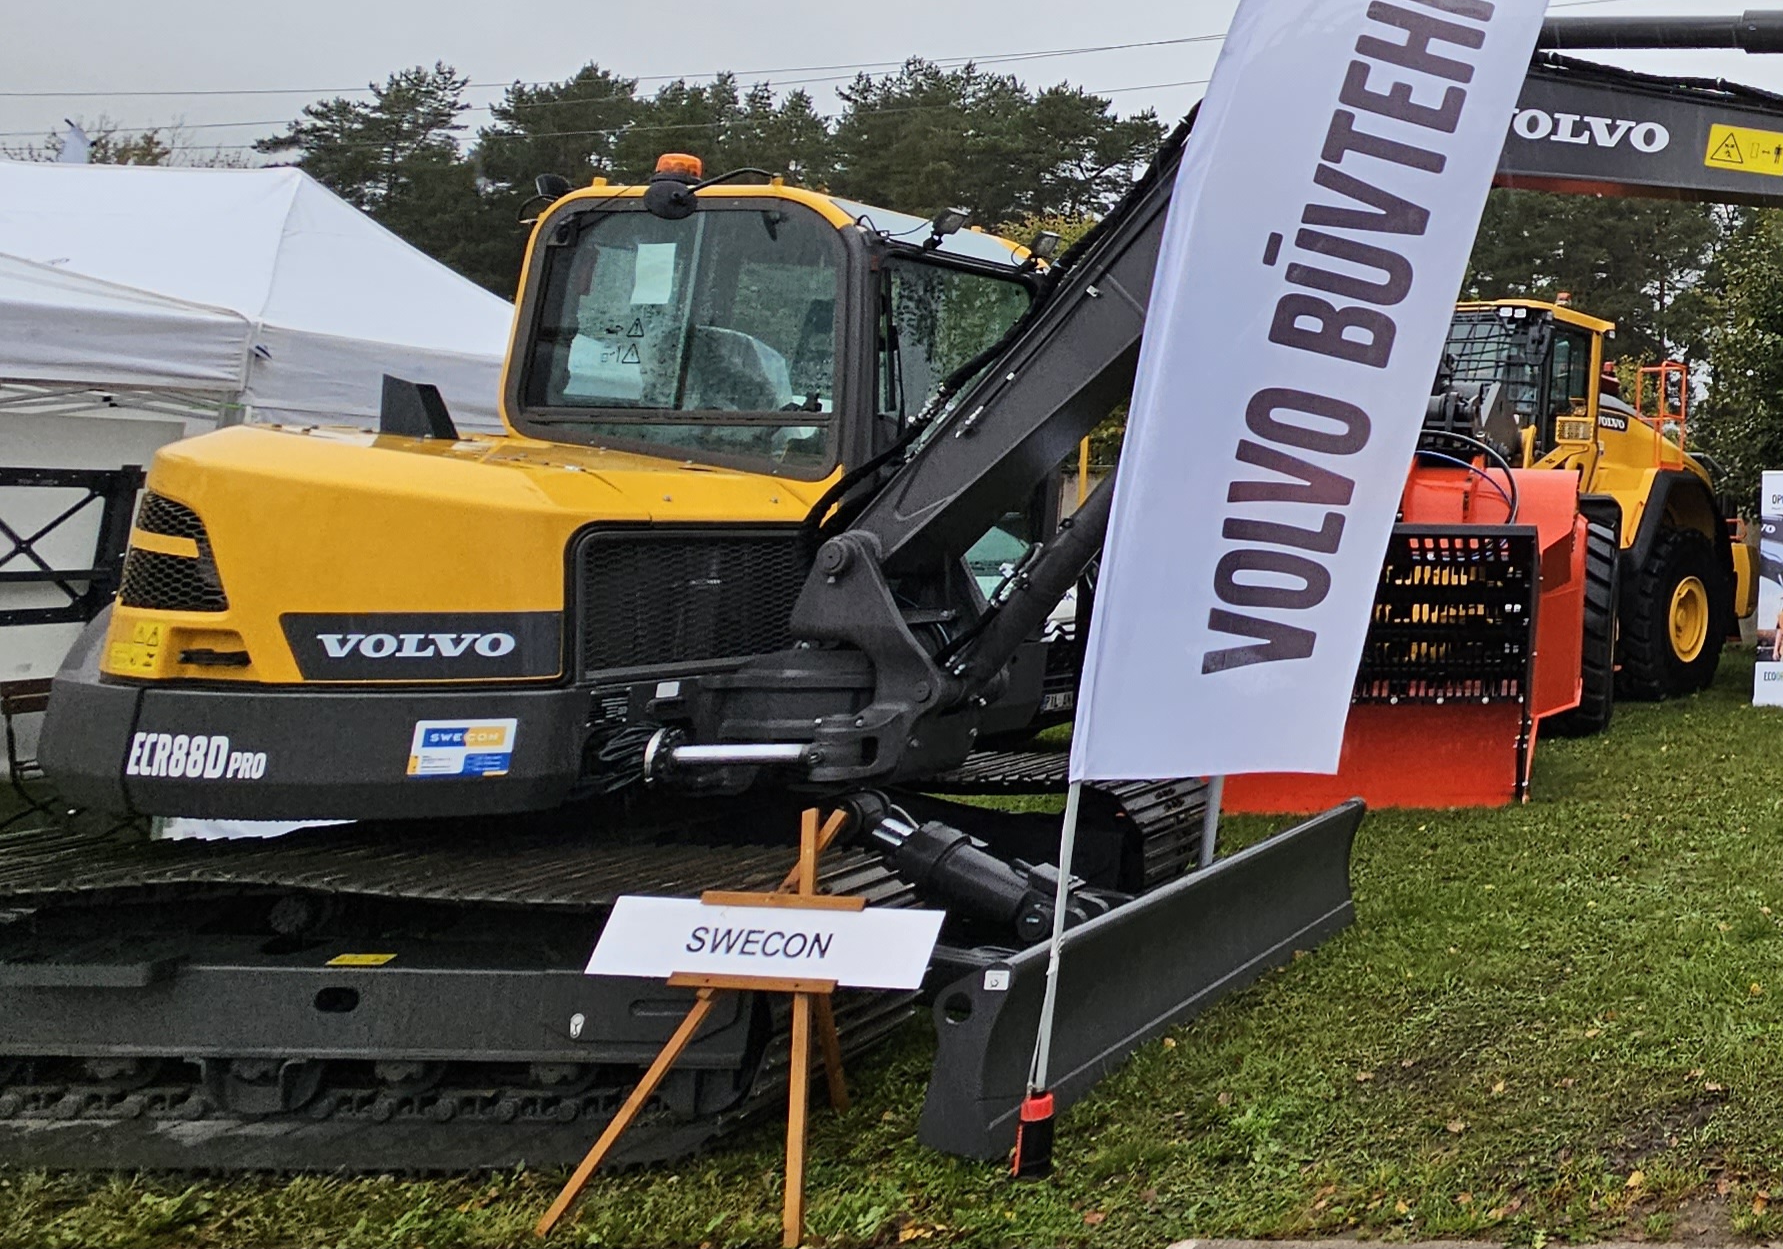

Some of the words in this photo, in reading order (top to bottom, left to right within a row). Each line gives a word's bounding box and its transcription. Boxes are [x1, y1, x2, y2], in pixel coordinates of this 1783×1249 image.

[1513, 108, 1670, 153] OLVO
[1201, 387, 1372, 675] VOLVO
[316, 633, 516, 658] VOLVO
[126, 732, 229, 779] ECR88D
[226, 752, 267, 780] PRO
[429, 732, 500, 743] SWECON
[685, 926, 834, 959] SWECON
